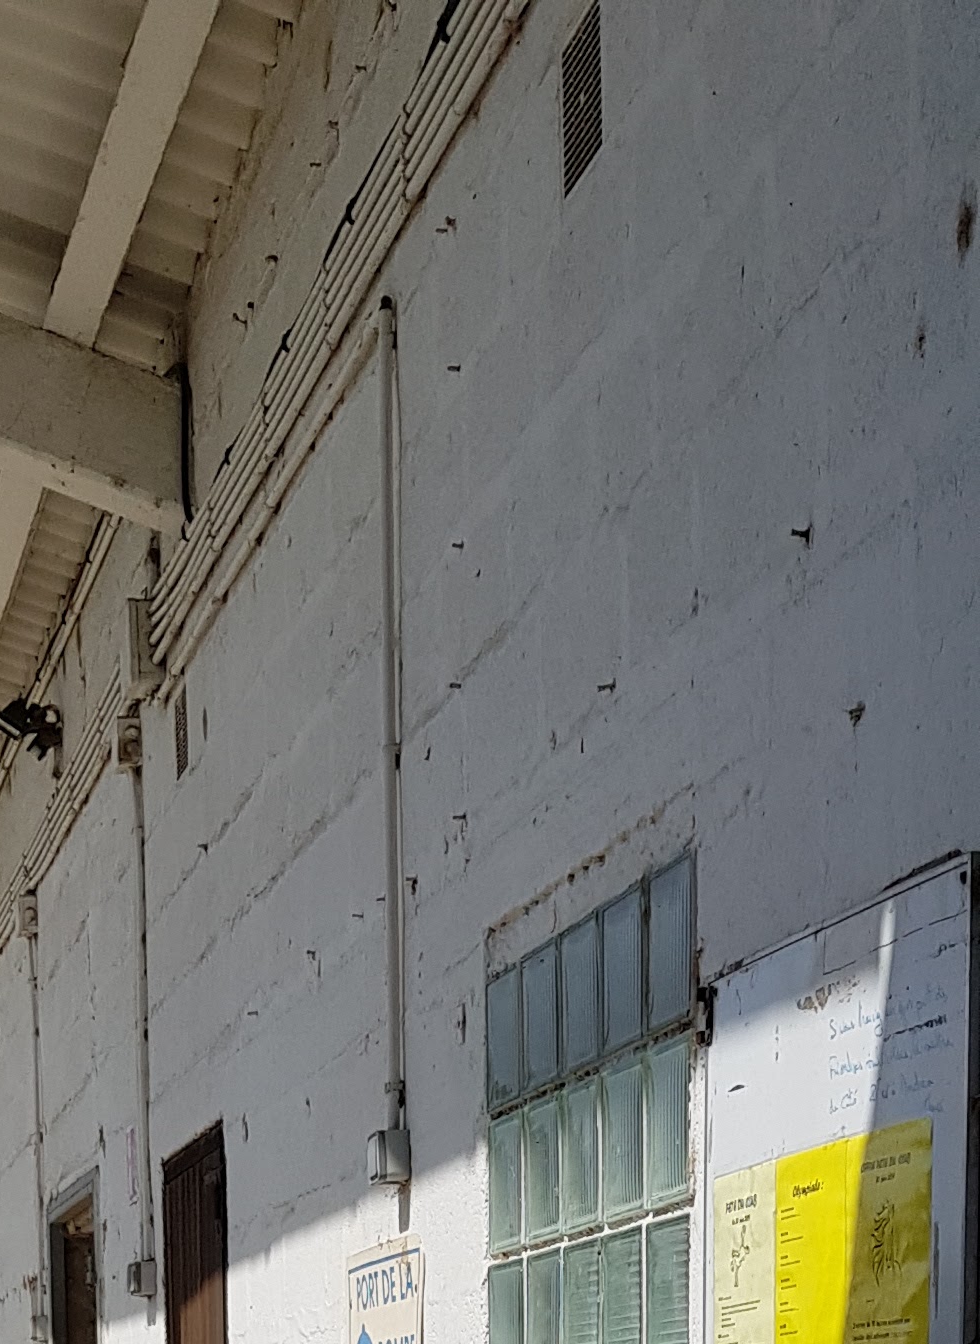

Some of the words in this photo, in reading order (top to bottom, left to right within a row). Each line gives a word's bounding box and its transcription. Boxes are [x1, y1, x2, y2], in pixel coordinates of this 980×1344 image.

[356, 1272, 379, 1312] PORT
[381, 1266, 397, 1305] DE
[399, 1261, 414, 1301] LA
